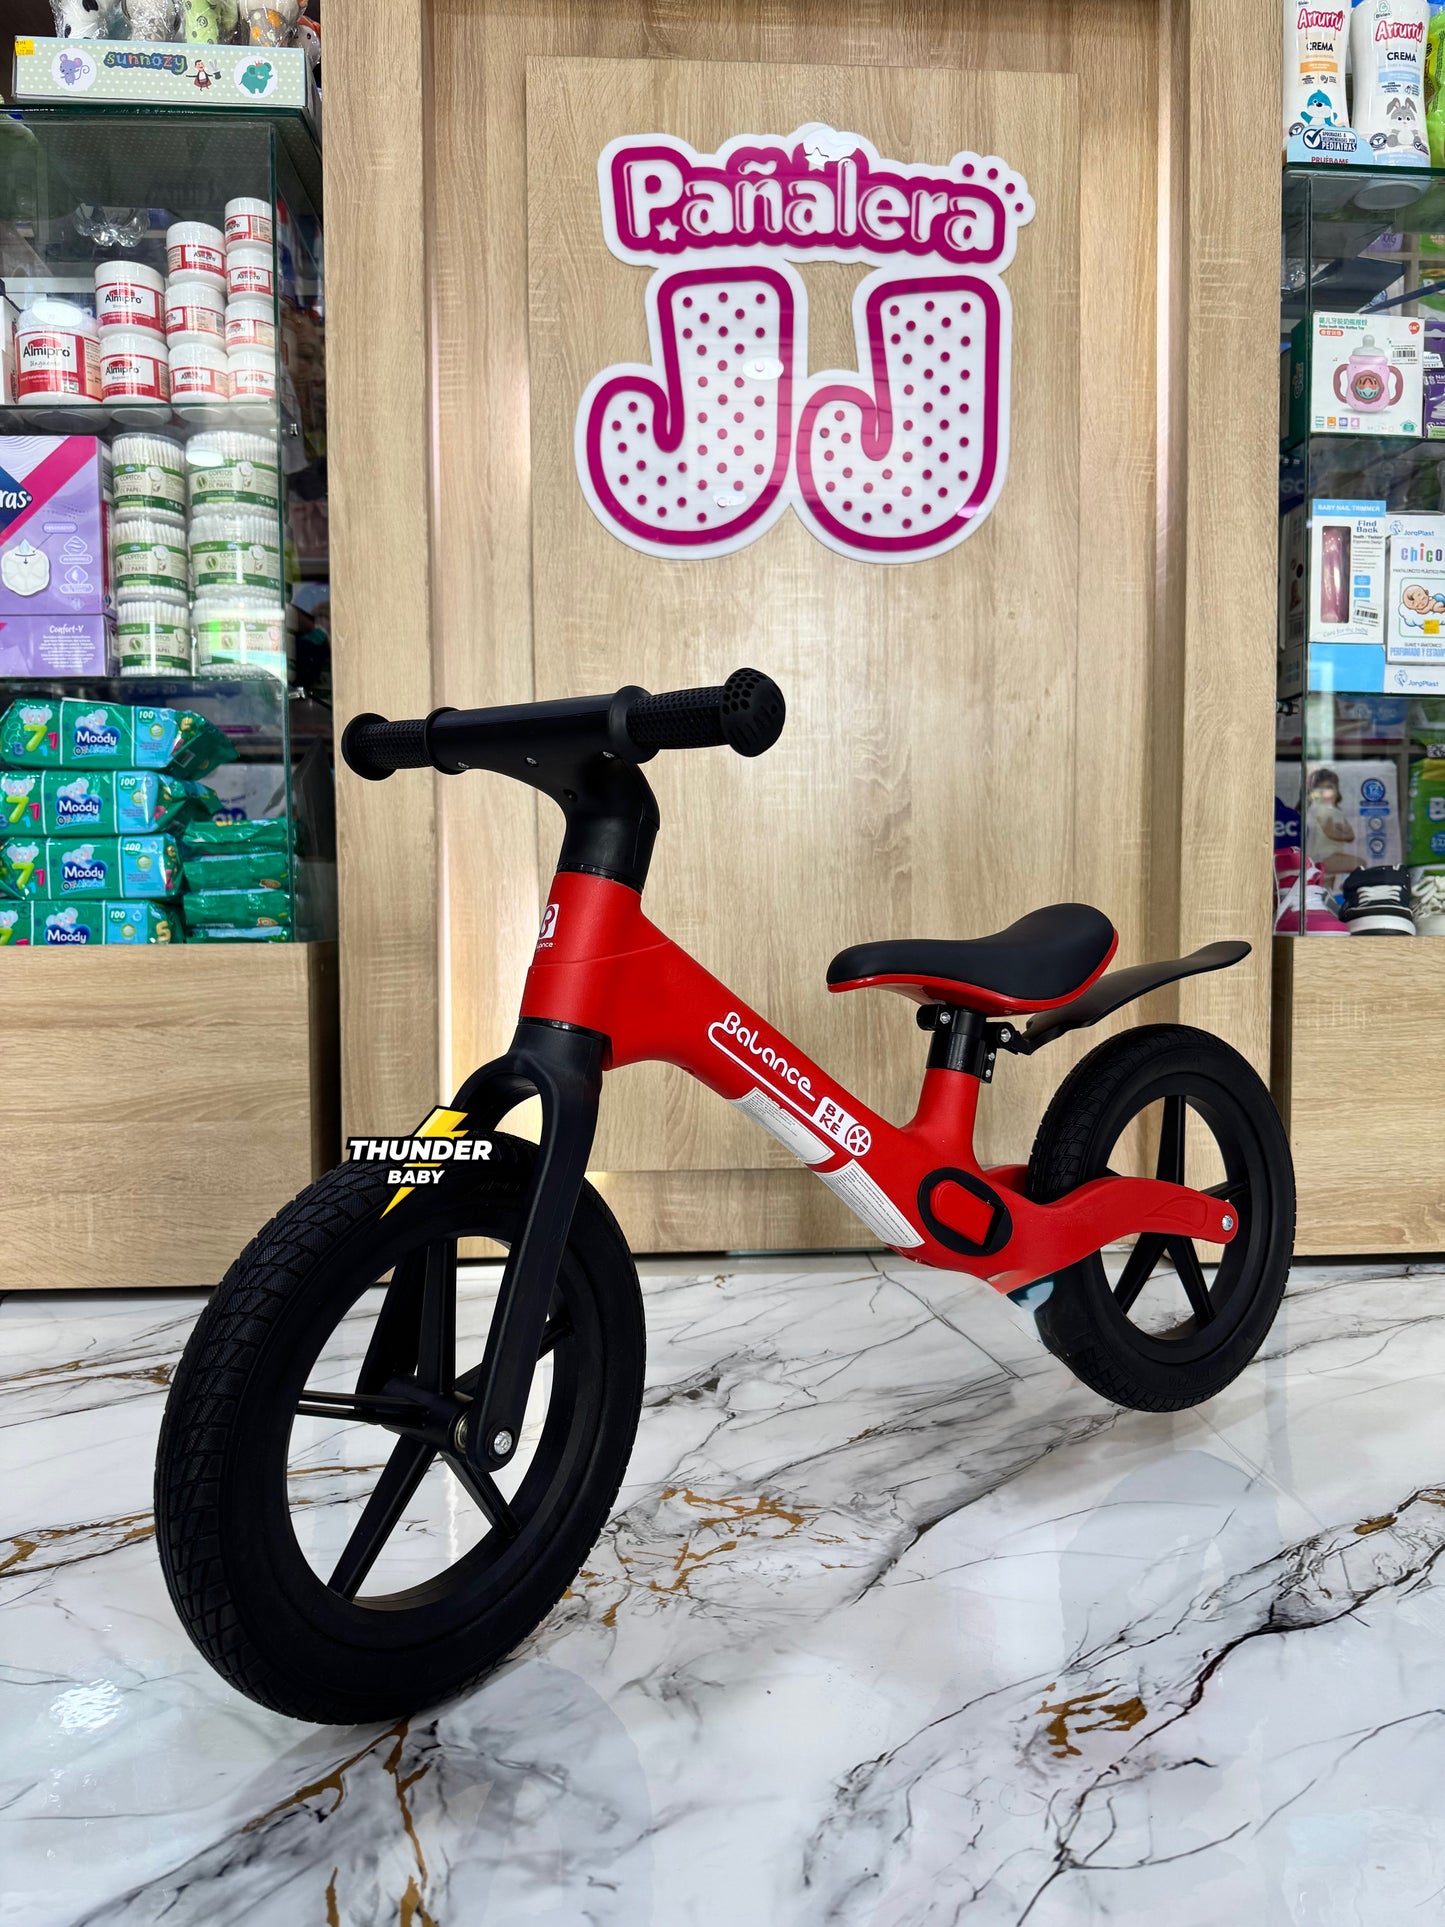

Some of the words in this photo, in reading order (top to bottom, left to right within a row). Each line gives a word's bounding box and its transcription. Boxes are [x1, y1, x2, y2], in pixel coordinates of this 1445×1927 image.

[106, 51, 187, 75] sunnozy
[1386, 51, 1417, 62] CREMA
[1322, 141, 1356, 151] PEDIATRAS
[624, 157, 997, 252] Pañalera
[105, 291, 142, 307] Almipro
[23, 344, 71, 358] Almipro
[105, 362, 139, 376] Almipro
[216, 481, 233, 489] PAPEL
[131, 565, 148, 573] PAPEL
[49, 624, 84, 634] Confort-V
[139, 710, 154, 720] 100
[76, 730, 117, 746] Moody
[120, 777, 135, 786] 100
[58, 800, 99, 813] Moody
[125, 843, 141, 851] 100
[64, 866, 105, 879] Moody
[110, 911, 125, 919] 100
[47, 929, 87, 943] Moody
[722, 1011, 816, 1102] Balance
